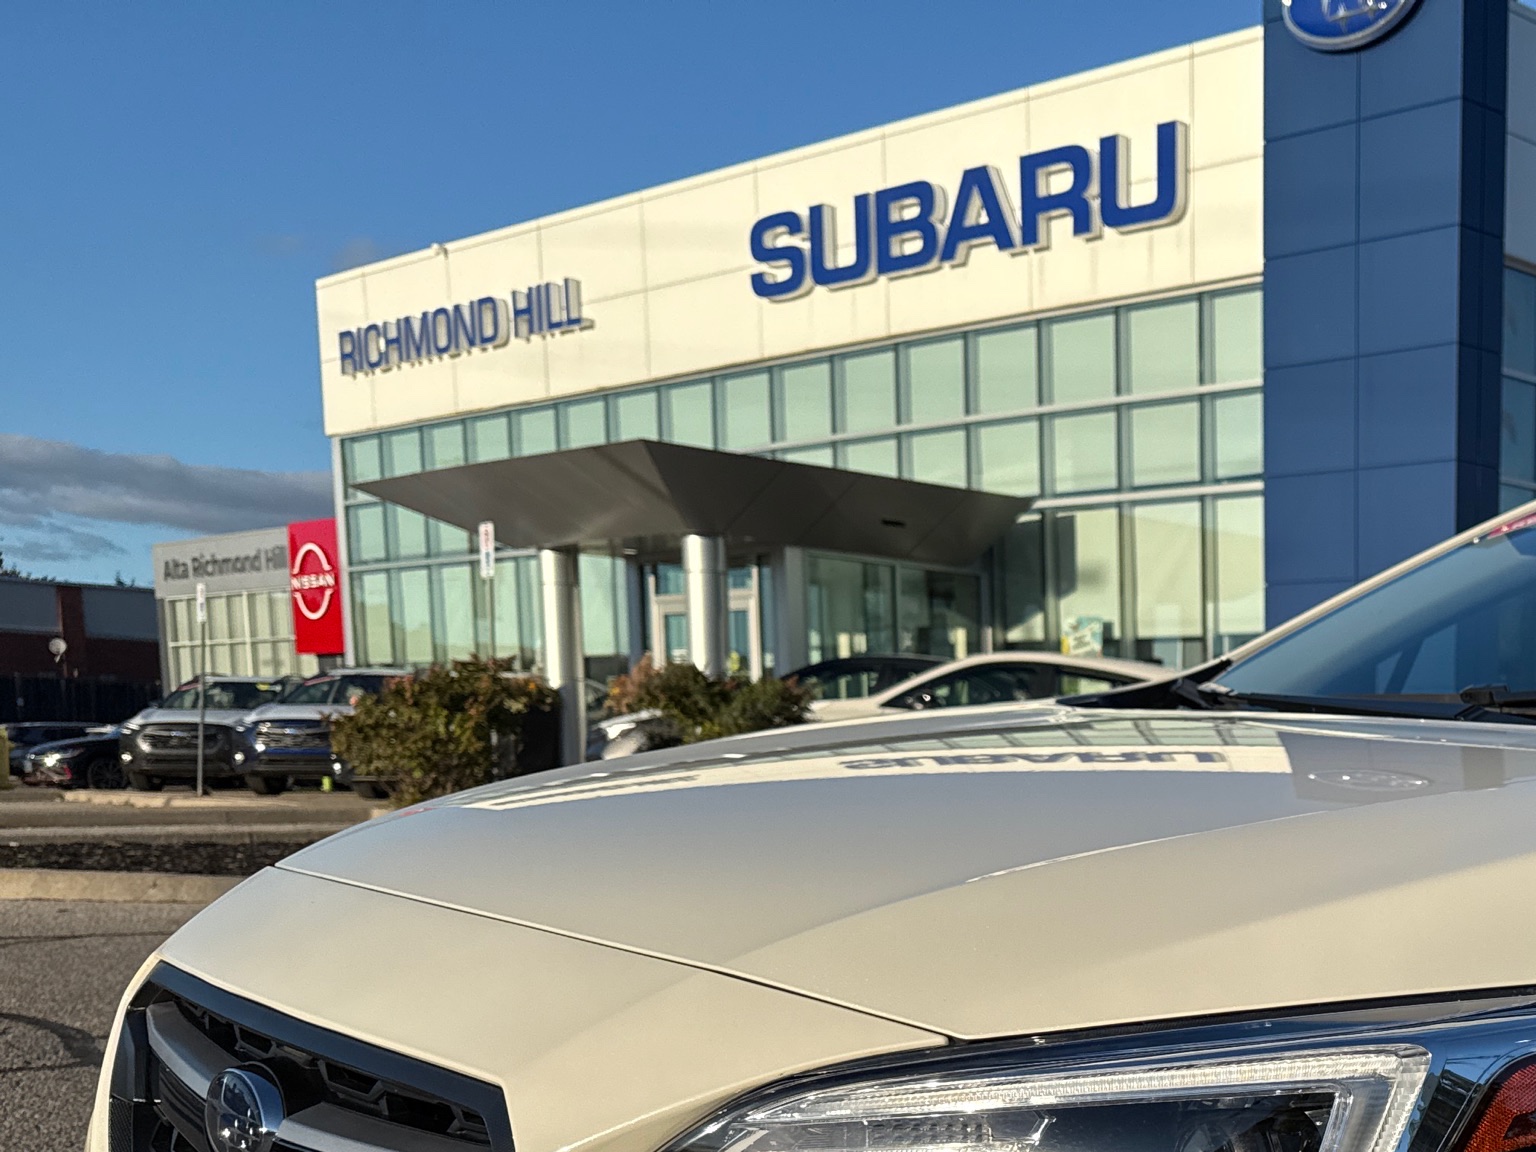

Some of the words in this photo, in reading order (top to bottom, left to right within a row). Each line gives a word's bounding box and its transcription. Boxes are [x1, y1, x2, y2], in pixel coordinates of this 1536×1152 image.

[750, 120, 1180, 299] SUBARU
[339, 296, 501, 376] RICHMOND
[511, 277, 583, 339] HILL
[163, 555, 190, 581] Alta
[191, 547, 264, 579] Richmond
[290, 572, 336, 591] NISSAN
